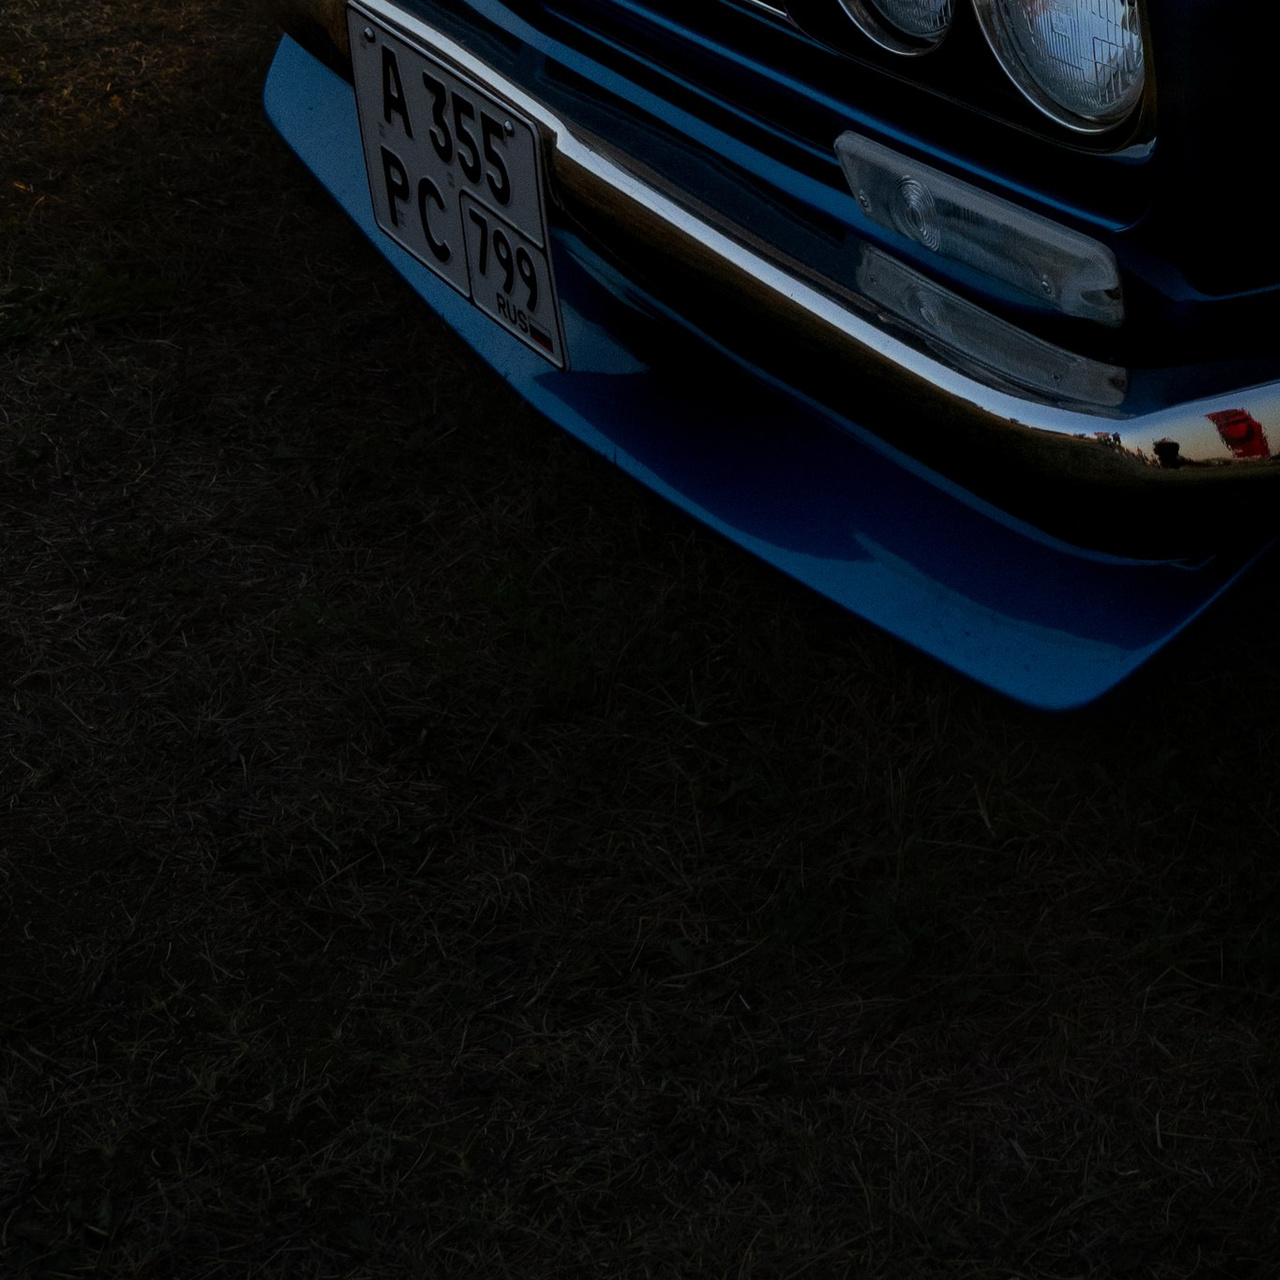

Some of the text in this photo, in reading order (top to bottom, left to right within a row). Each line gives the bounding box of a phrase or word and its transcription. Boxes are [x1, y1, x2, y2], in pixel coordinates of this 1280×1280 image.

[422, 72, 511, 206] 355
[469, 207, 539, 313] 799
[497, 291, 529, 334] RUS
